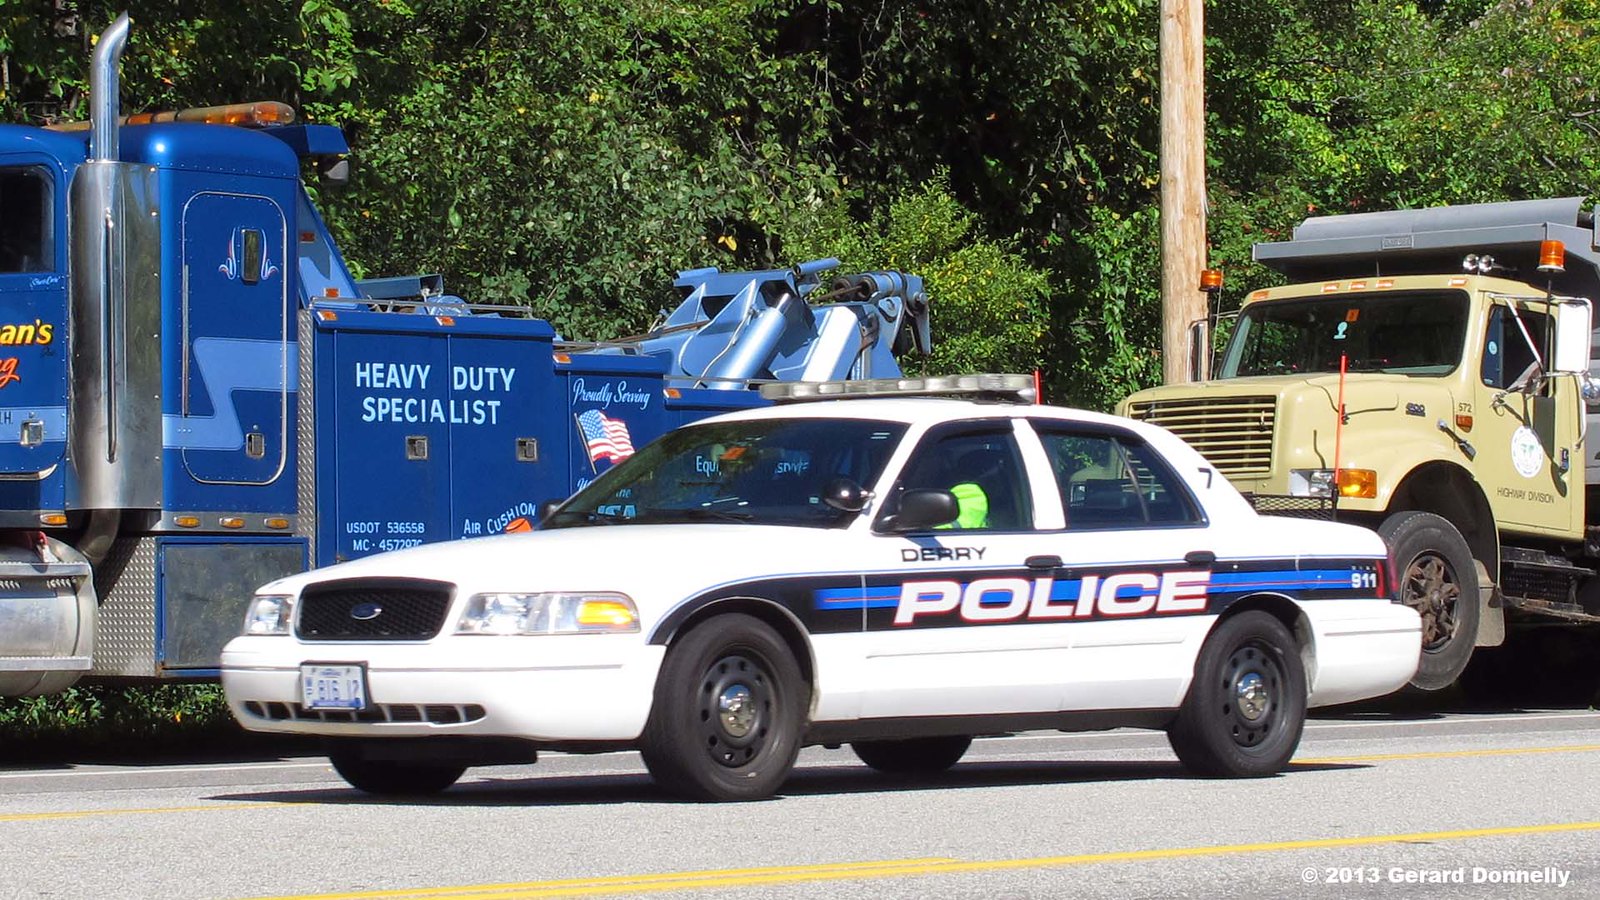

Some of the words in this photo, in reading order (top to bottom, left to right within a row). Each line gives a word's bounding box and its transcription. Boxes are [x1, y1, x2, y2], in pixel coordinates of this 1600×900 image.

[356, 363, 431, 389] HEAVY
[453, 366, 515, 392] DUTY
[572, 377, 612, 410] Proudly
[613, 380, 651, 411] Serving
[361, 396, 501, 425] SPECIALIST
[1458, 402, 1472, 413] 572
[1197, 467, 1213, 489] 7
[1497, 487, 1527, 500] HIGHWAY
[1528, 491, 1555, 504] DIVISION
[346, 522, 380, 534] USDOT
[387, 523, 425, 534] 536558
[487, 502, 536, 535] CUSHION
[900, 546, 988, 563] DERRY
[1351, 572, 1377, 588] 911
[893, 569, 1212, 626] POLICE
